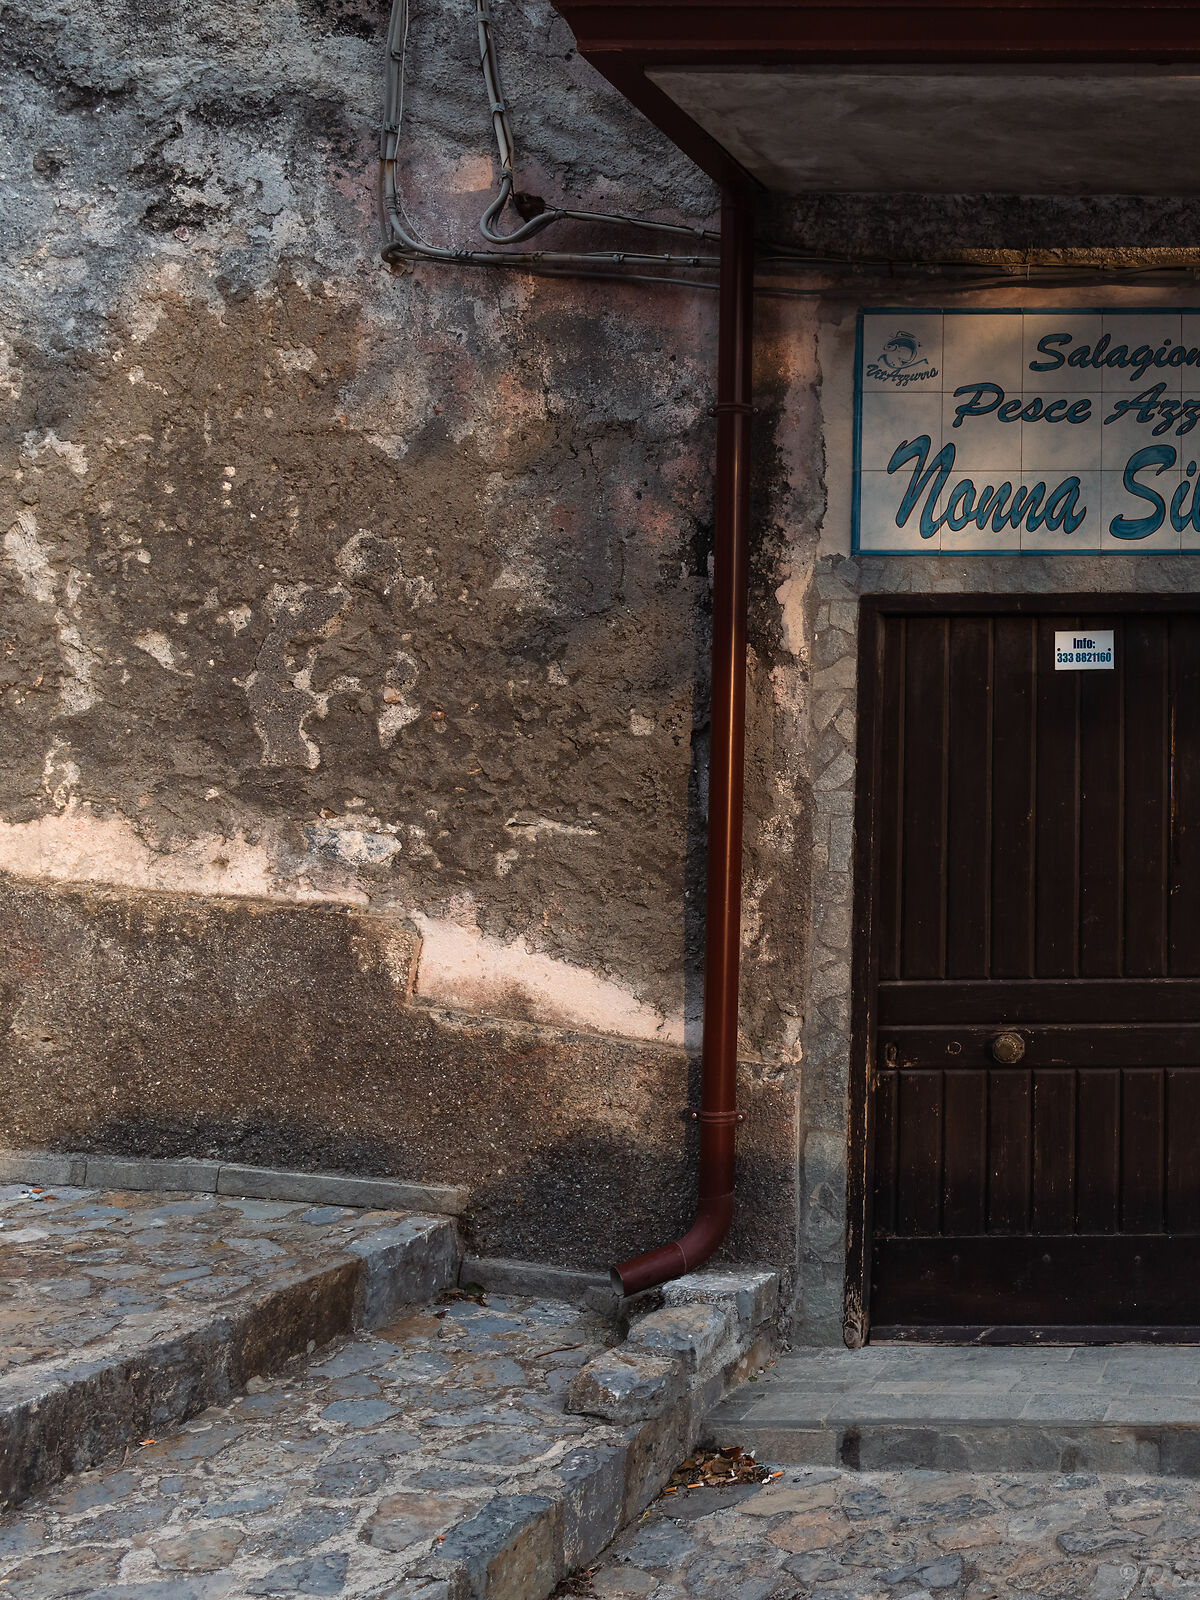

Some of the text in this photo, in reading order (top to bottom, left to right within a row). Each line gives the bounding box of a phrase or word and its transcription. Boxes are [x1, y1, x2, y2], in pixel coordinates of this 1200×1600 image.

[953, 382, 1092, 428] Pesce
[887, 434, 1087, 539] Nonna
[1057, 652, 1112, 662] 333 8821160
[1073, 638, 1096, 648] Info:
